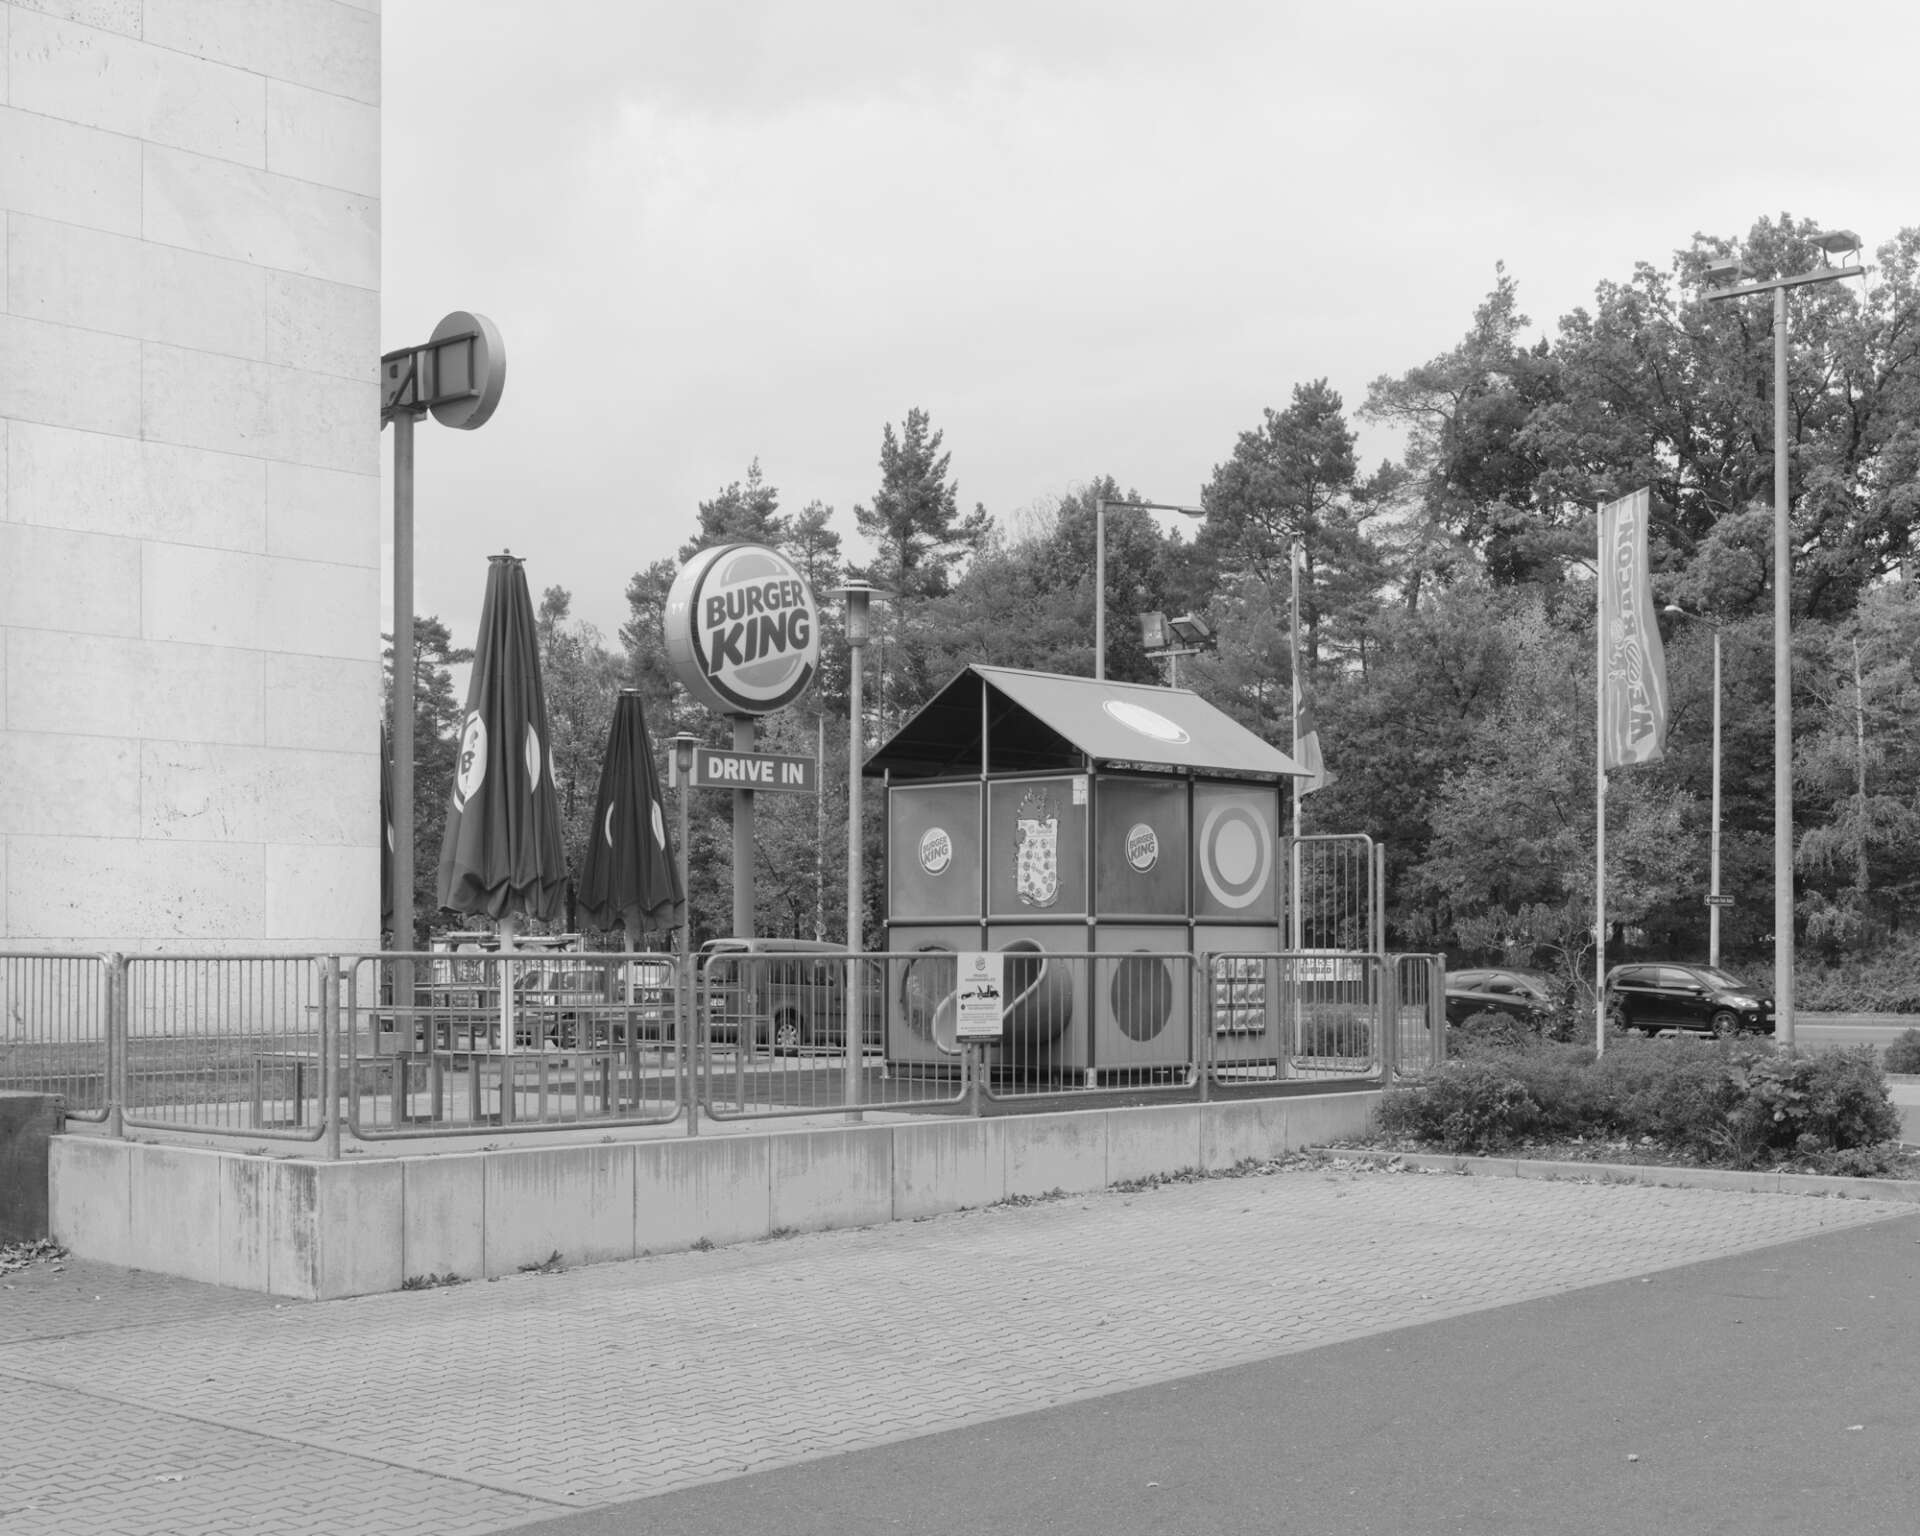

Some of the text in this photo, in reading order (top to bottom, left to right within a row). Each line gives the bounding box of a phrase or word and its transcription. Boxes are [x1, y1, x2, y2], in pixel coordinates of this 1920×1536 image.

[706, 579, 805, 630] BURGER
[710, 608, 810, 674] KING
[1618, 521, 1654, 745] WE BACON
[708, 756, 804, 785] DRIVE IN
[923, 843, 949, 865] KING
[1130, 841, 1155, 861] KING
